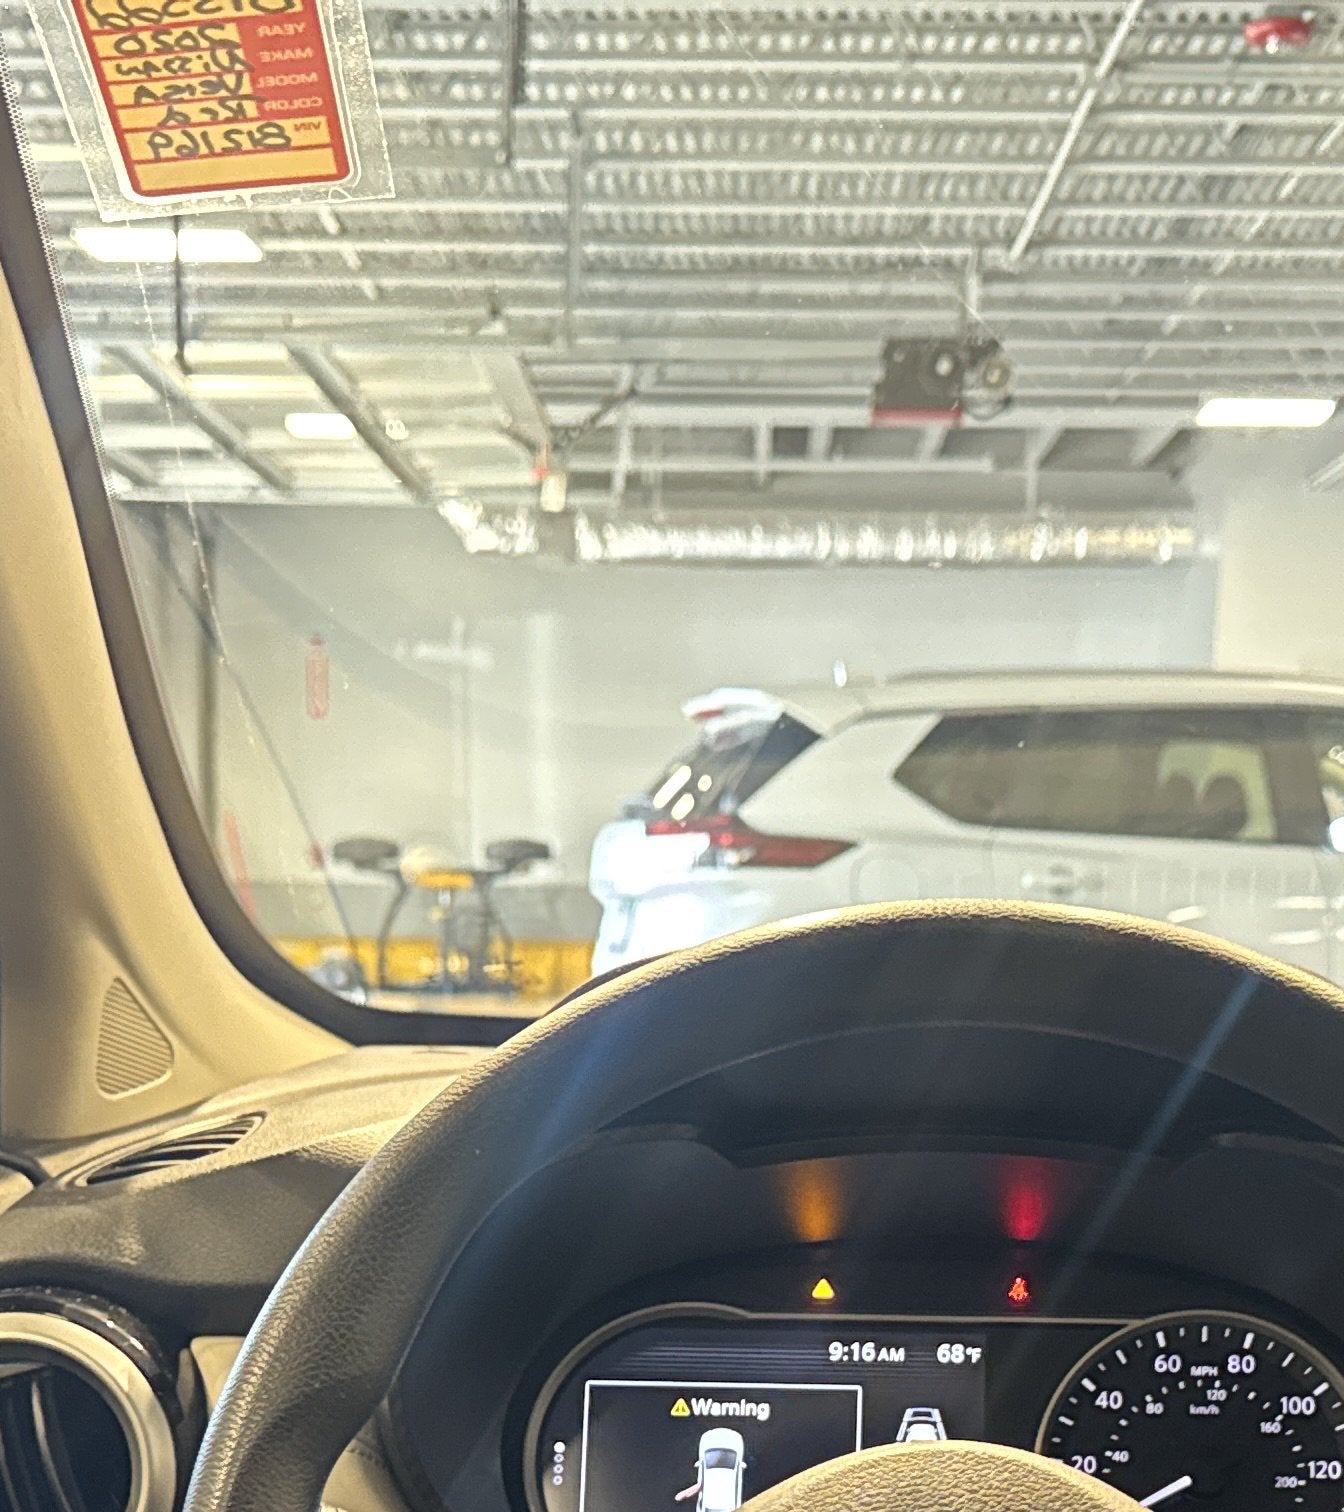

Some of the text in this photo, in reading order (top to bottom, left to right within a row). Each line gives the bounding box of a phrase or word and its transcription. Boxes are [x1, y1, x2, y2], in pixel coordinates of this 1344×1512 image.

[1154, 1354, 1181, 1373] 60
[1227, 1354, 1255, 1374] 80
[1190, 1366, 1219, 1377] MPH
[1095, 1390, 1123, 1410] 40
[1206, 1389, 1227, 1401] 120
[691, 1398, 770, 1421] Warning
[1145, 1403, 1164, 1414] 80
[1189, 1404, 1220, 1415] km/h
[1280, 1396, 1315, 1415] 100
[1260, 1422, 1281, 1433] 160
[1111, 1450, 1129, 1462] 40
[1071, 1455, 1096, 1473] 20
[1307, 1460, 1342, 1479] 120
[1275, 1477, 1297, 1488] 200
